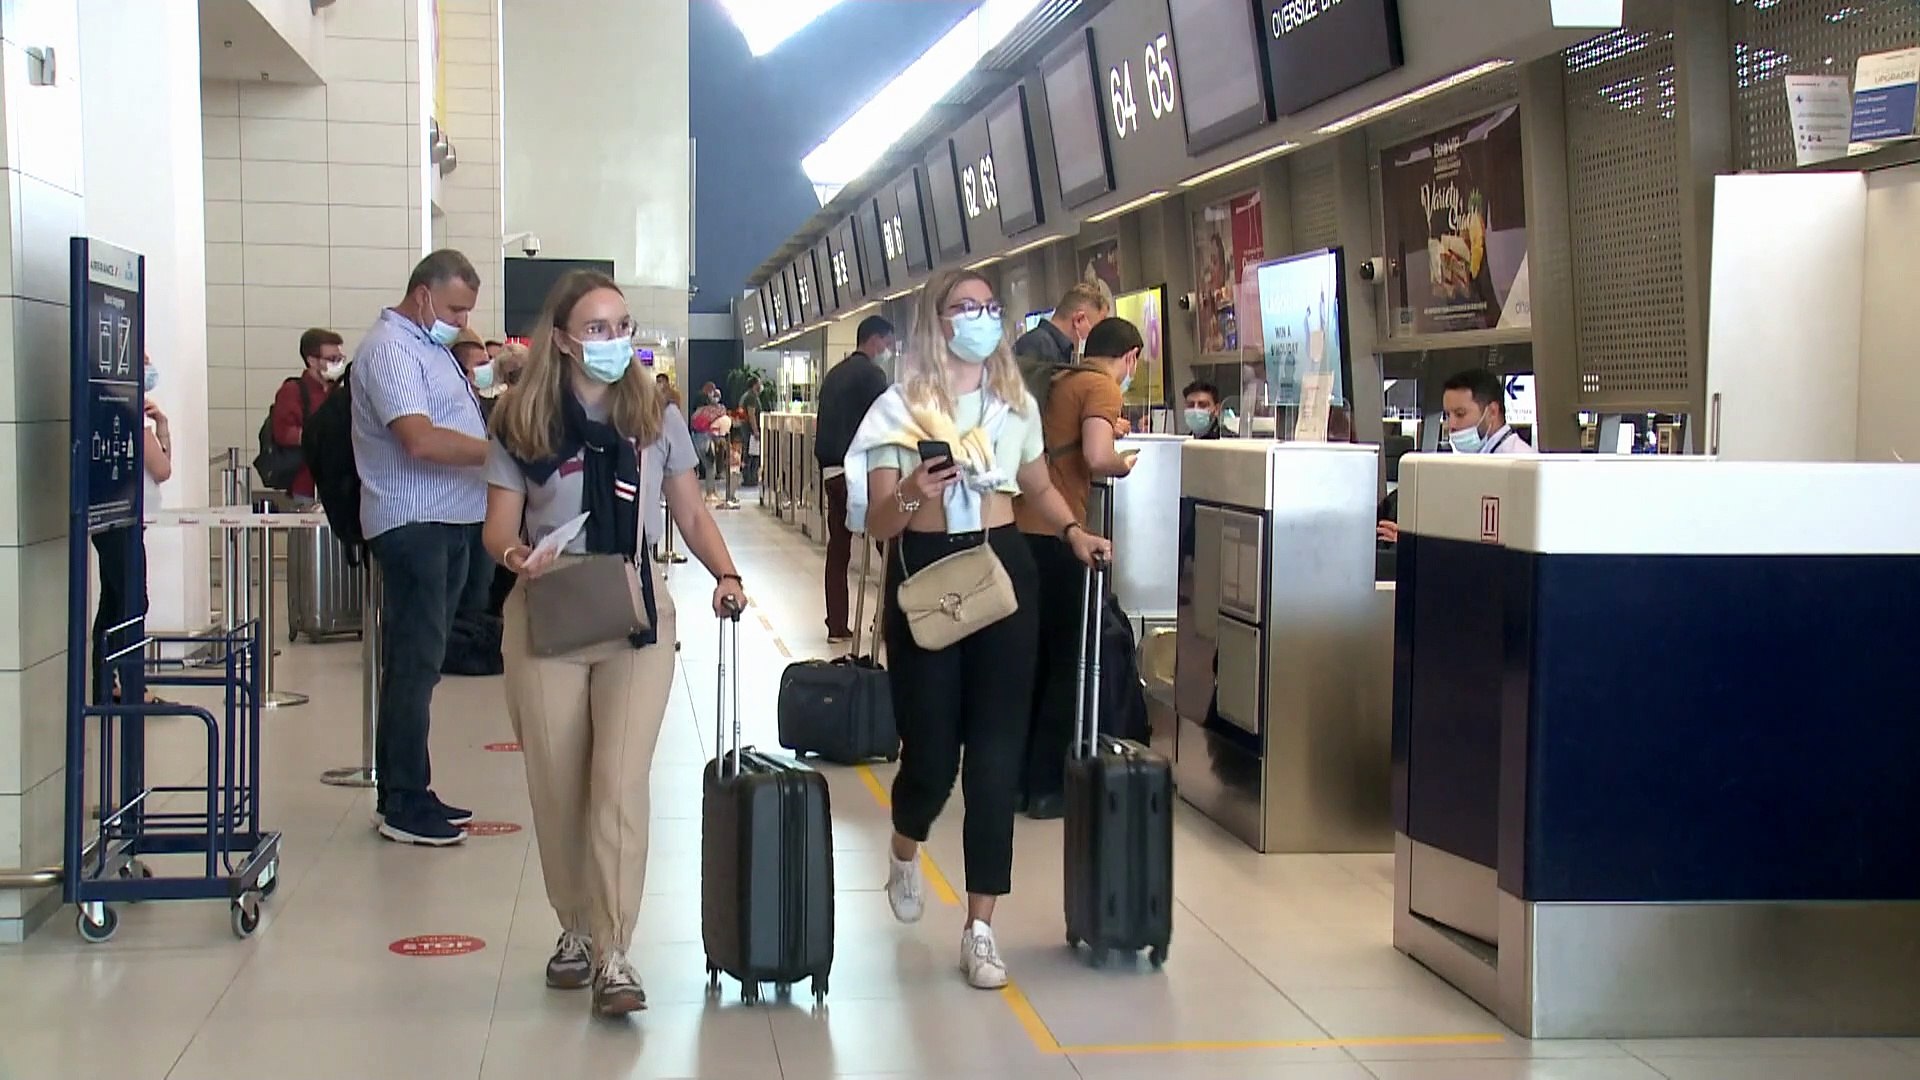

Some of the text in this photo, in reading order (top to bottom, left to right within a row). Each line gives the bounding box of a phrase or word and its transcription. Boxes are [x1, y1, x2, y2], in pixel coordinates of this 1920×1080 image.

[1272, 0, 1318, 38] OVERSIZE
[1109, 33, 1175, 139] 64 65
[963, 154, 998, 219] 62 63
